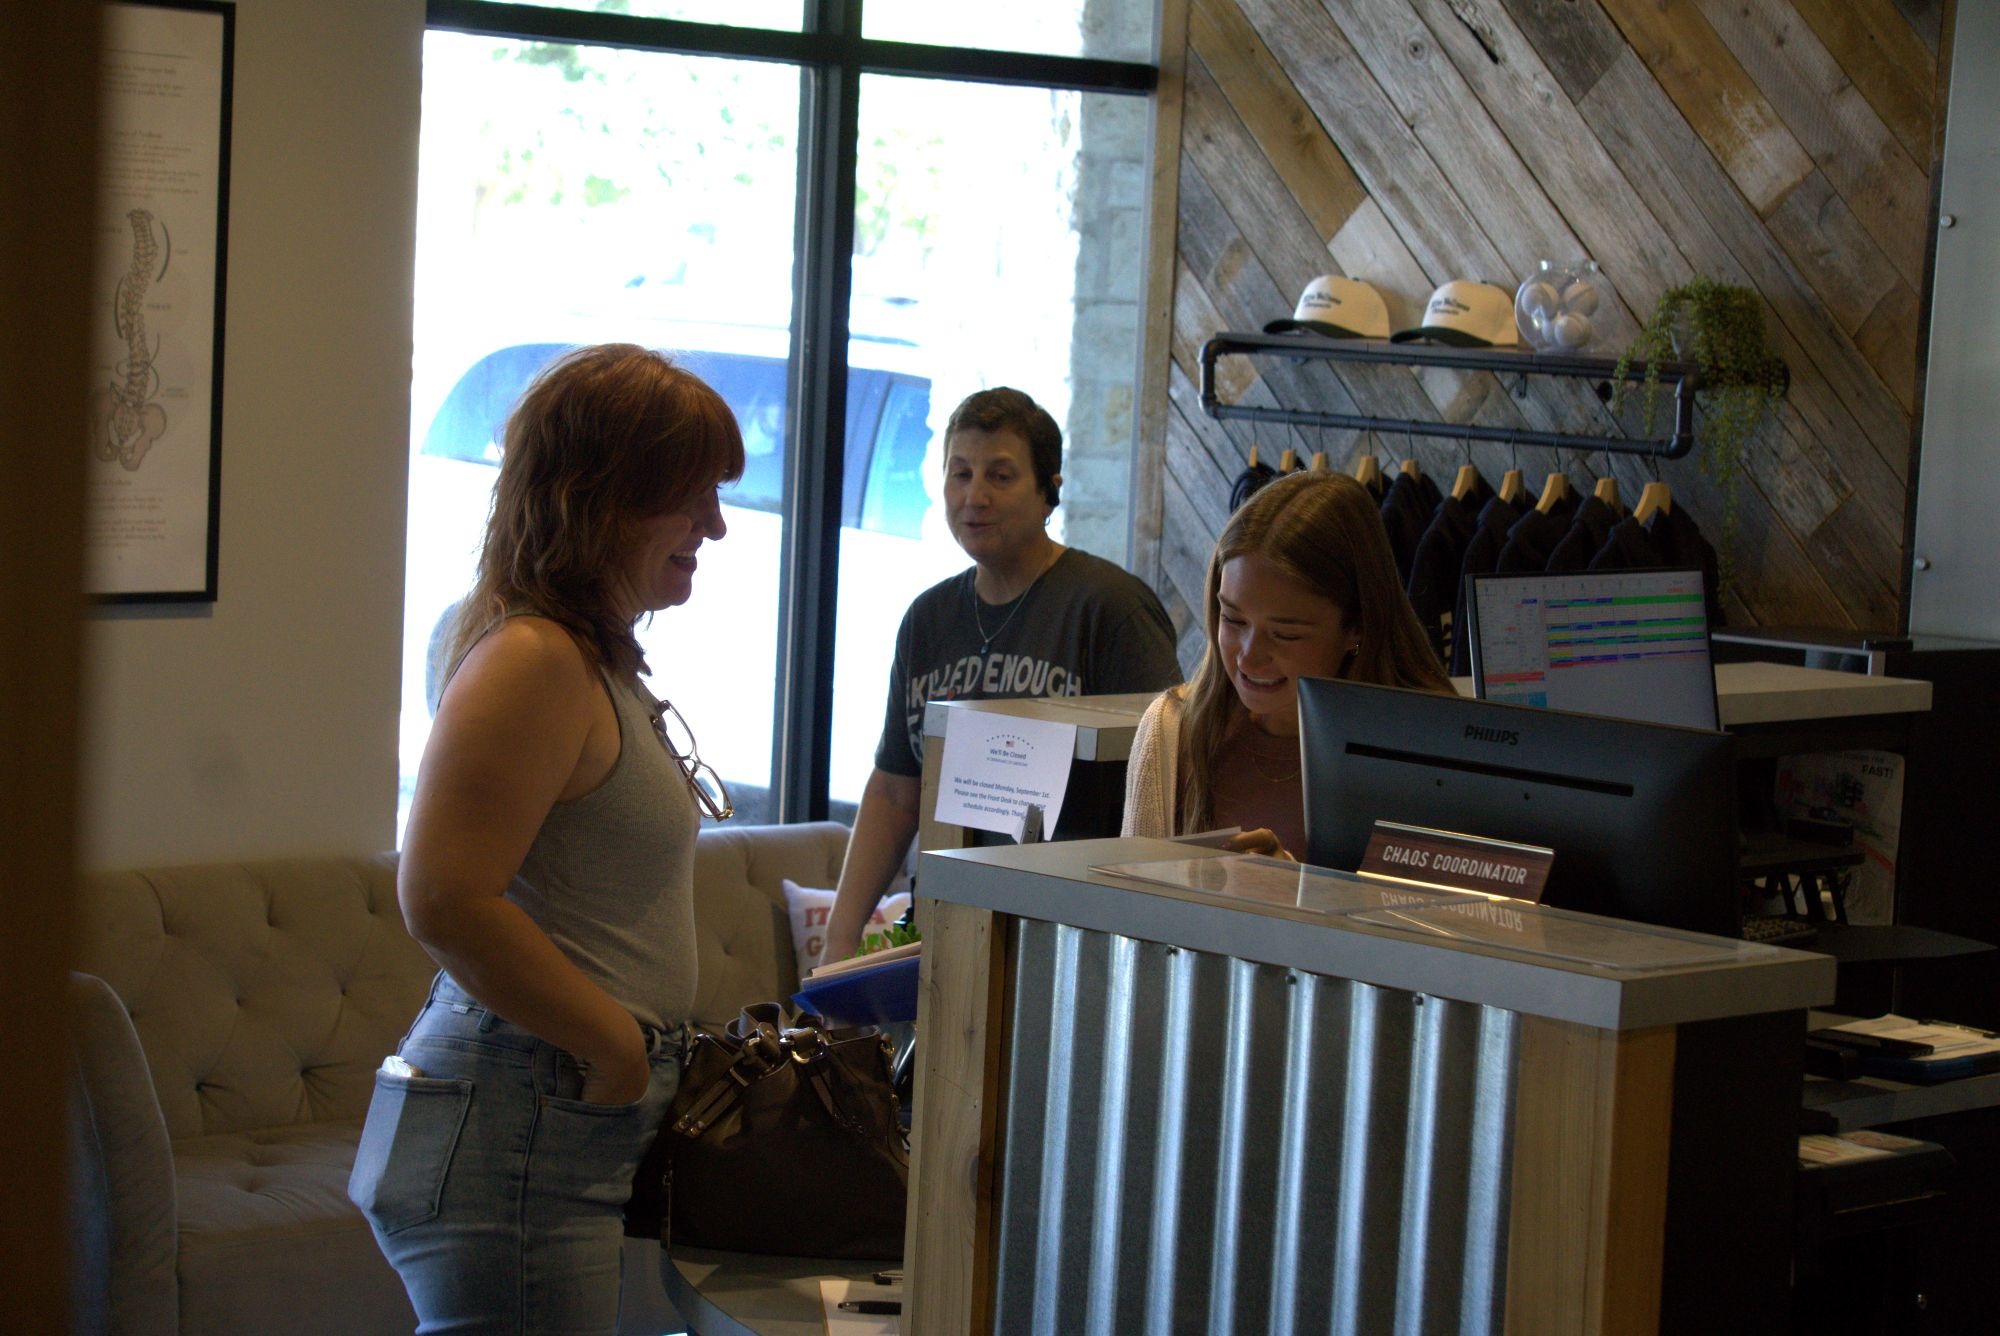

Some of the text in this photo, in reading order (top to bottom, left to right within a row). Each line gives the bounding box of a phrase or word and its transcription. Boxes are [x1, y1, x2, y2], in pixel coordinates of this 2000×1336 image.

[983, 653, 1082, 697] ENOUGH
[1464, 724, 1520, 746] PHILIPS
[1010, 751, 1027, 760] Closed
[954, 789, 969, 797] Please
[978, 791, 987, 800] the
[987, 793, 1001, 802] Front
[1001, 795, 1012, 804] Desk
[979, 781, 995, 789] closed
[995, 783, 1015, 793] Monday,
[1016, 786, 1041, 797] September
[963, 802, 983, 811] schedule
[1382, 844, 1528, 885] CHAOS COORDINATOR
